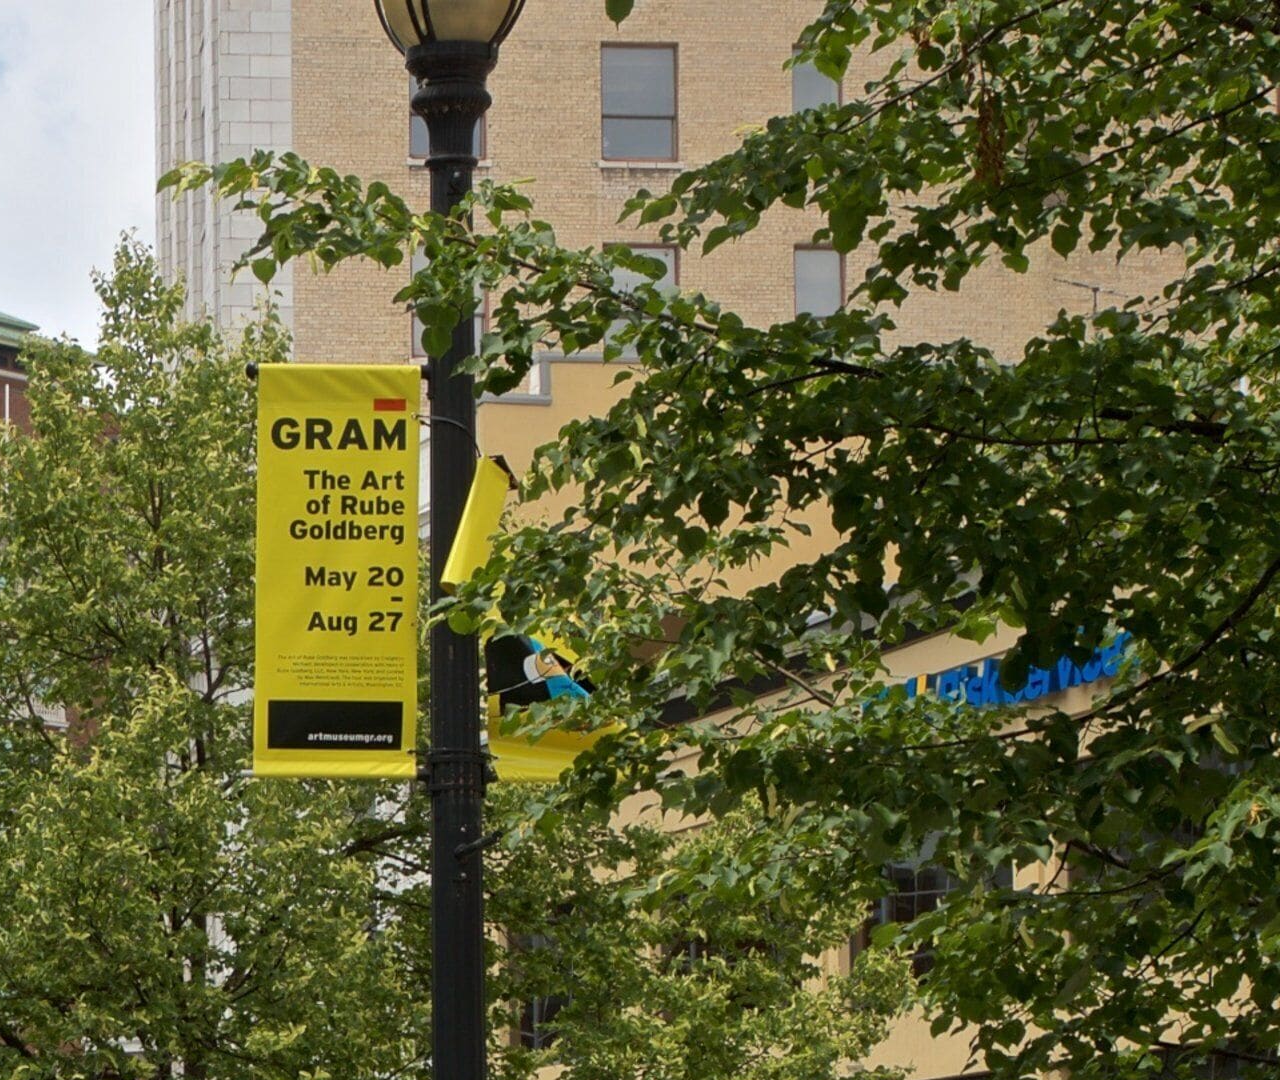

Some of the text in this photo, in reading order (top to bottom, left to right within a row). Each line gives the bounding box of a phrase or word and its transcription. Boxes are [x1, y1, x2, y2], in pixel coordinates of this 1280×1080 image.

[271, 417, 406, 450] GRAM
[303, 469, 405, 490] The Art
[306, 494, 405, 515] of Rube
[290, 519, 404, 545] Goldberg
[305, 566, 404, 591] May 20
[307, 611, 403, 637] Aug 27
[308, 732, 393, 744] artmuseumgr.org
